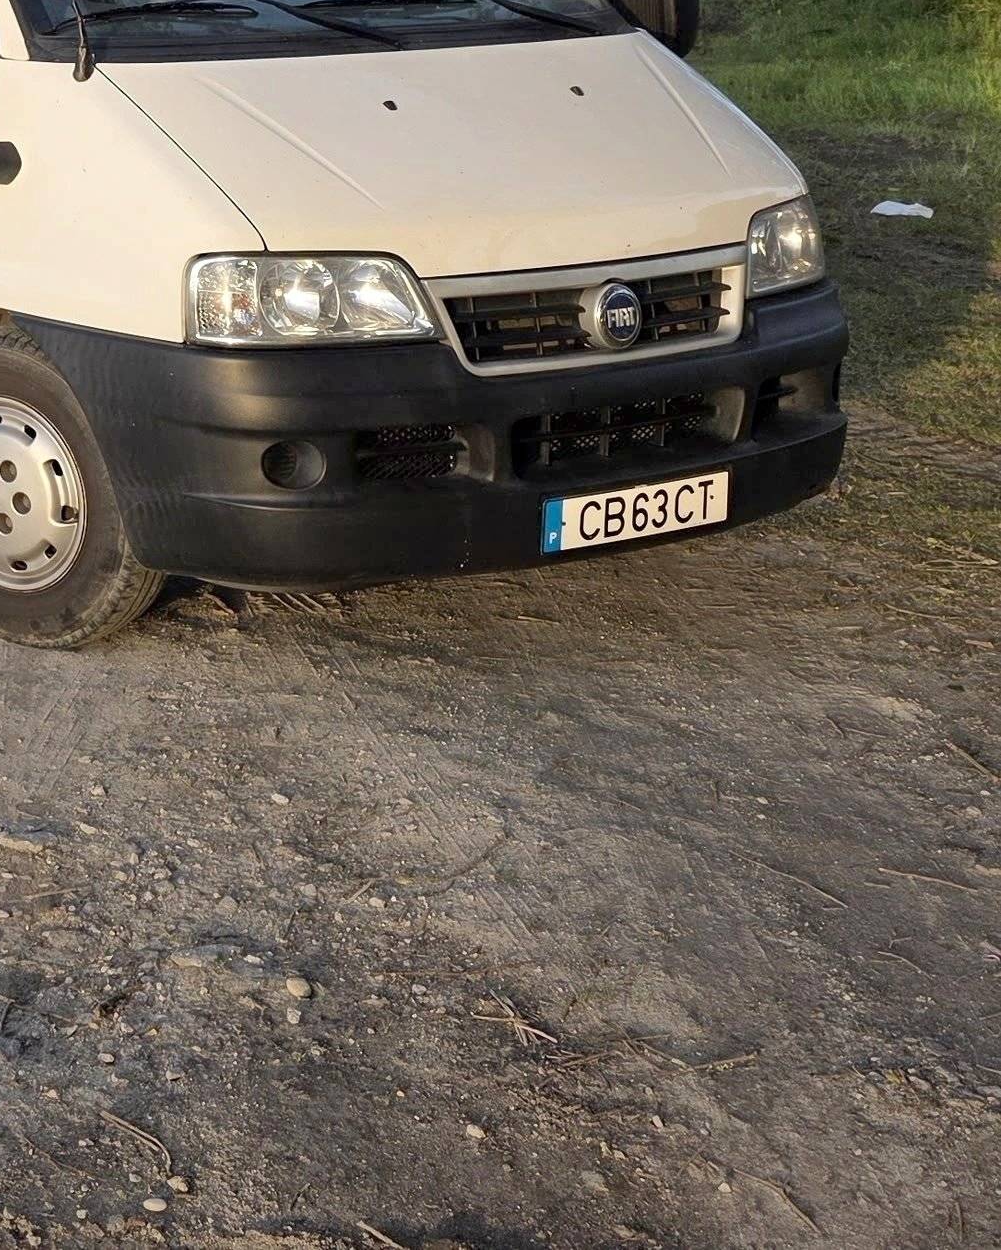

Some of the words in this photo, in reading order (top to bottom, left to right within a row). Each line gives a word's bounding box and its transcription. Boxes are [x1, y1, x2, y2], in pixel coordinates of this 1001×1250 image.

[606, 306, 636, 329] FIAT
[579, 479, 714, 541] CB63CT
[549, 532, 557, 544] P
